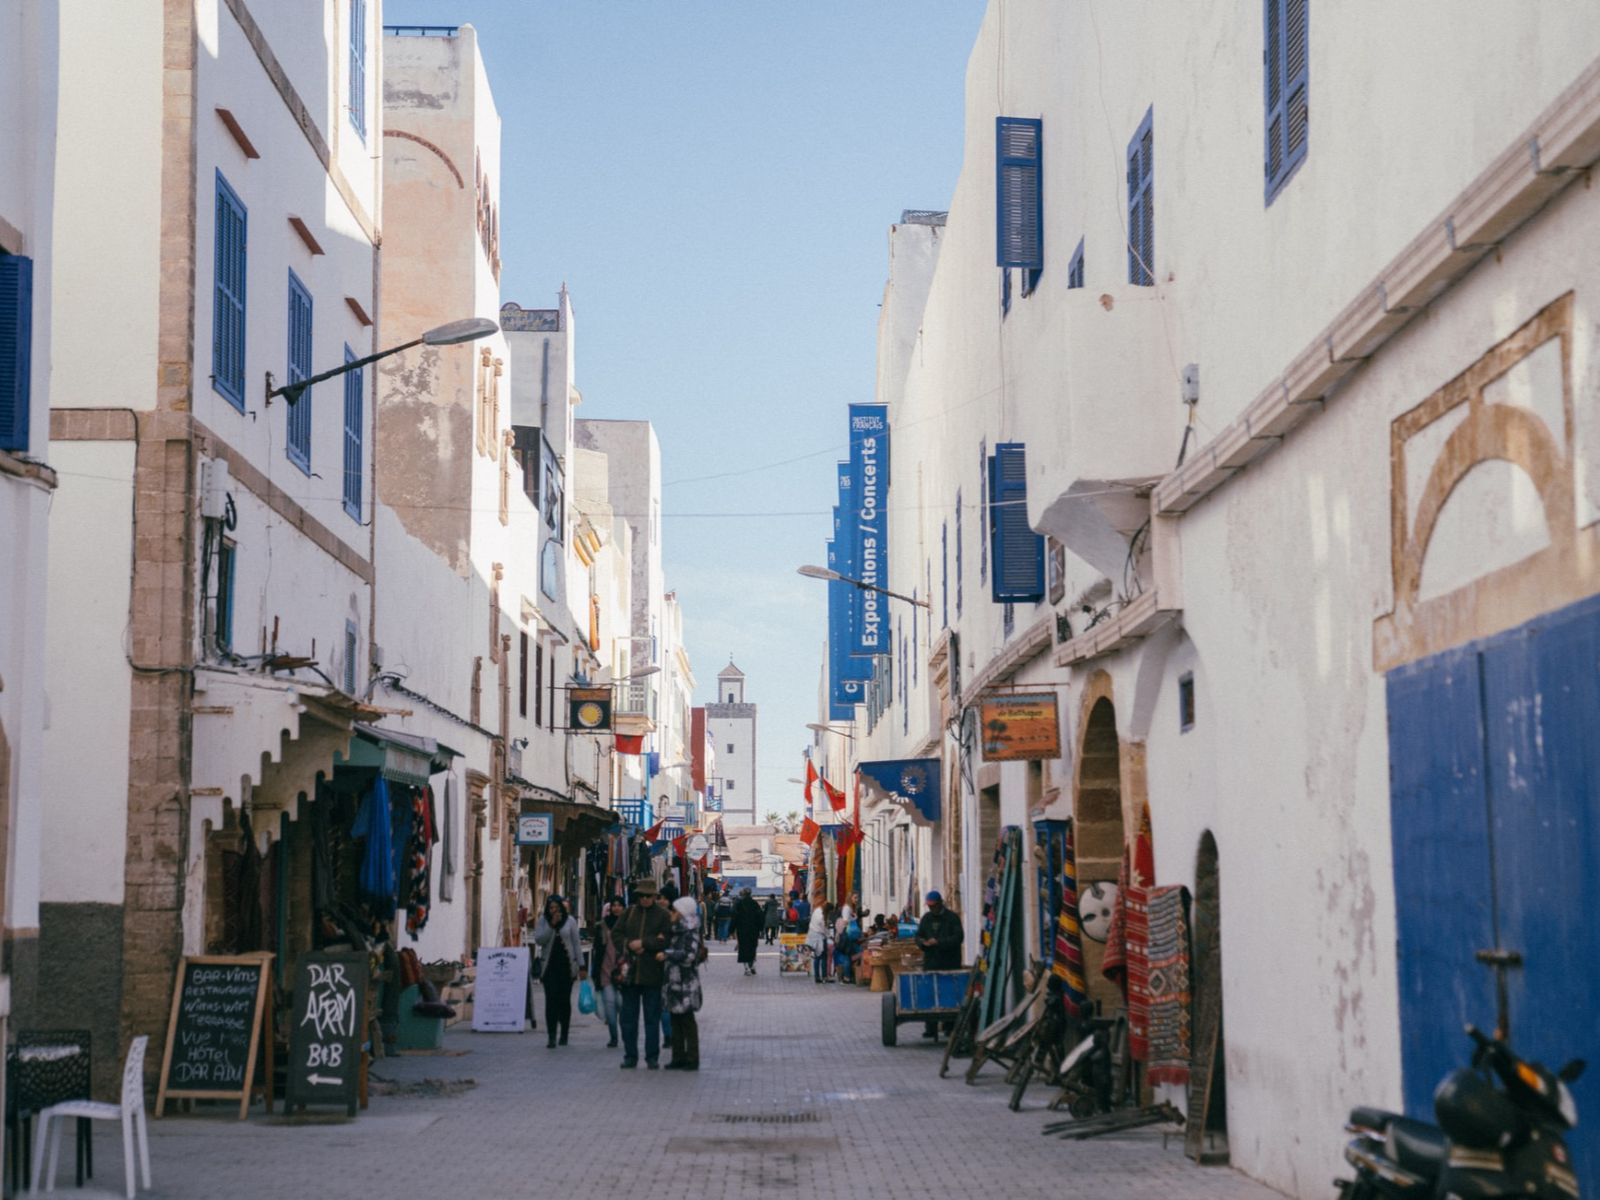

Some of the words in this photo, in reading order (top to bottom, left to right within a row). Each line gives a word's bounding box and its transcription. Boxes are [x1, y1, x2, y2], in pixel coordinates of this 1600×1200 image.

[861, 437, 877, 520] Concerts
[862, 538, 880, 646] Expostions
[307, 964, 350, 991] DAR
